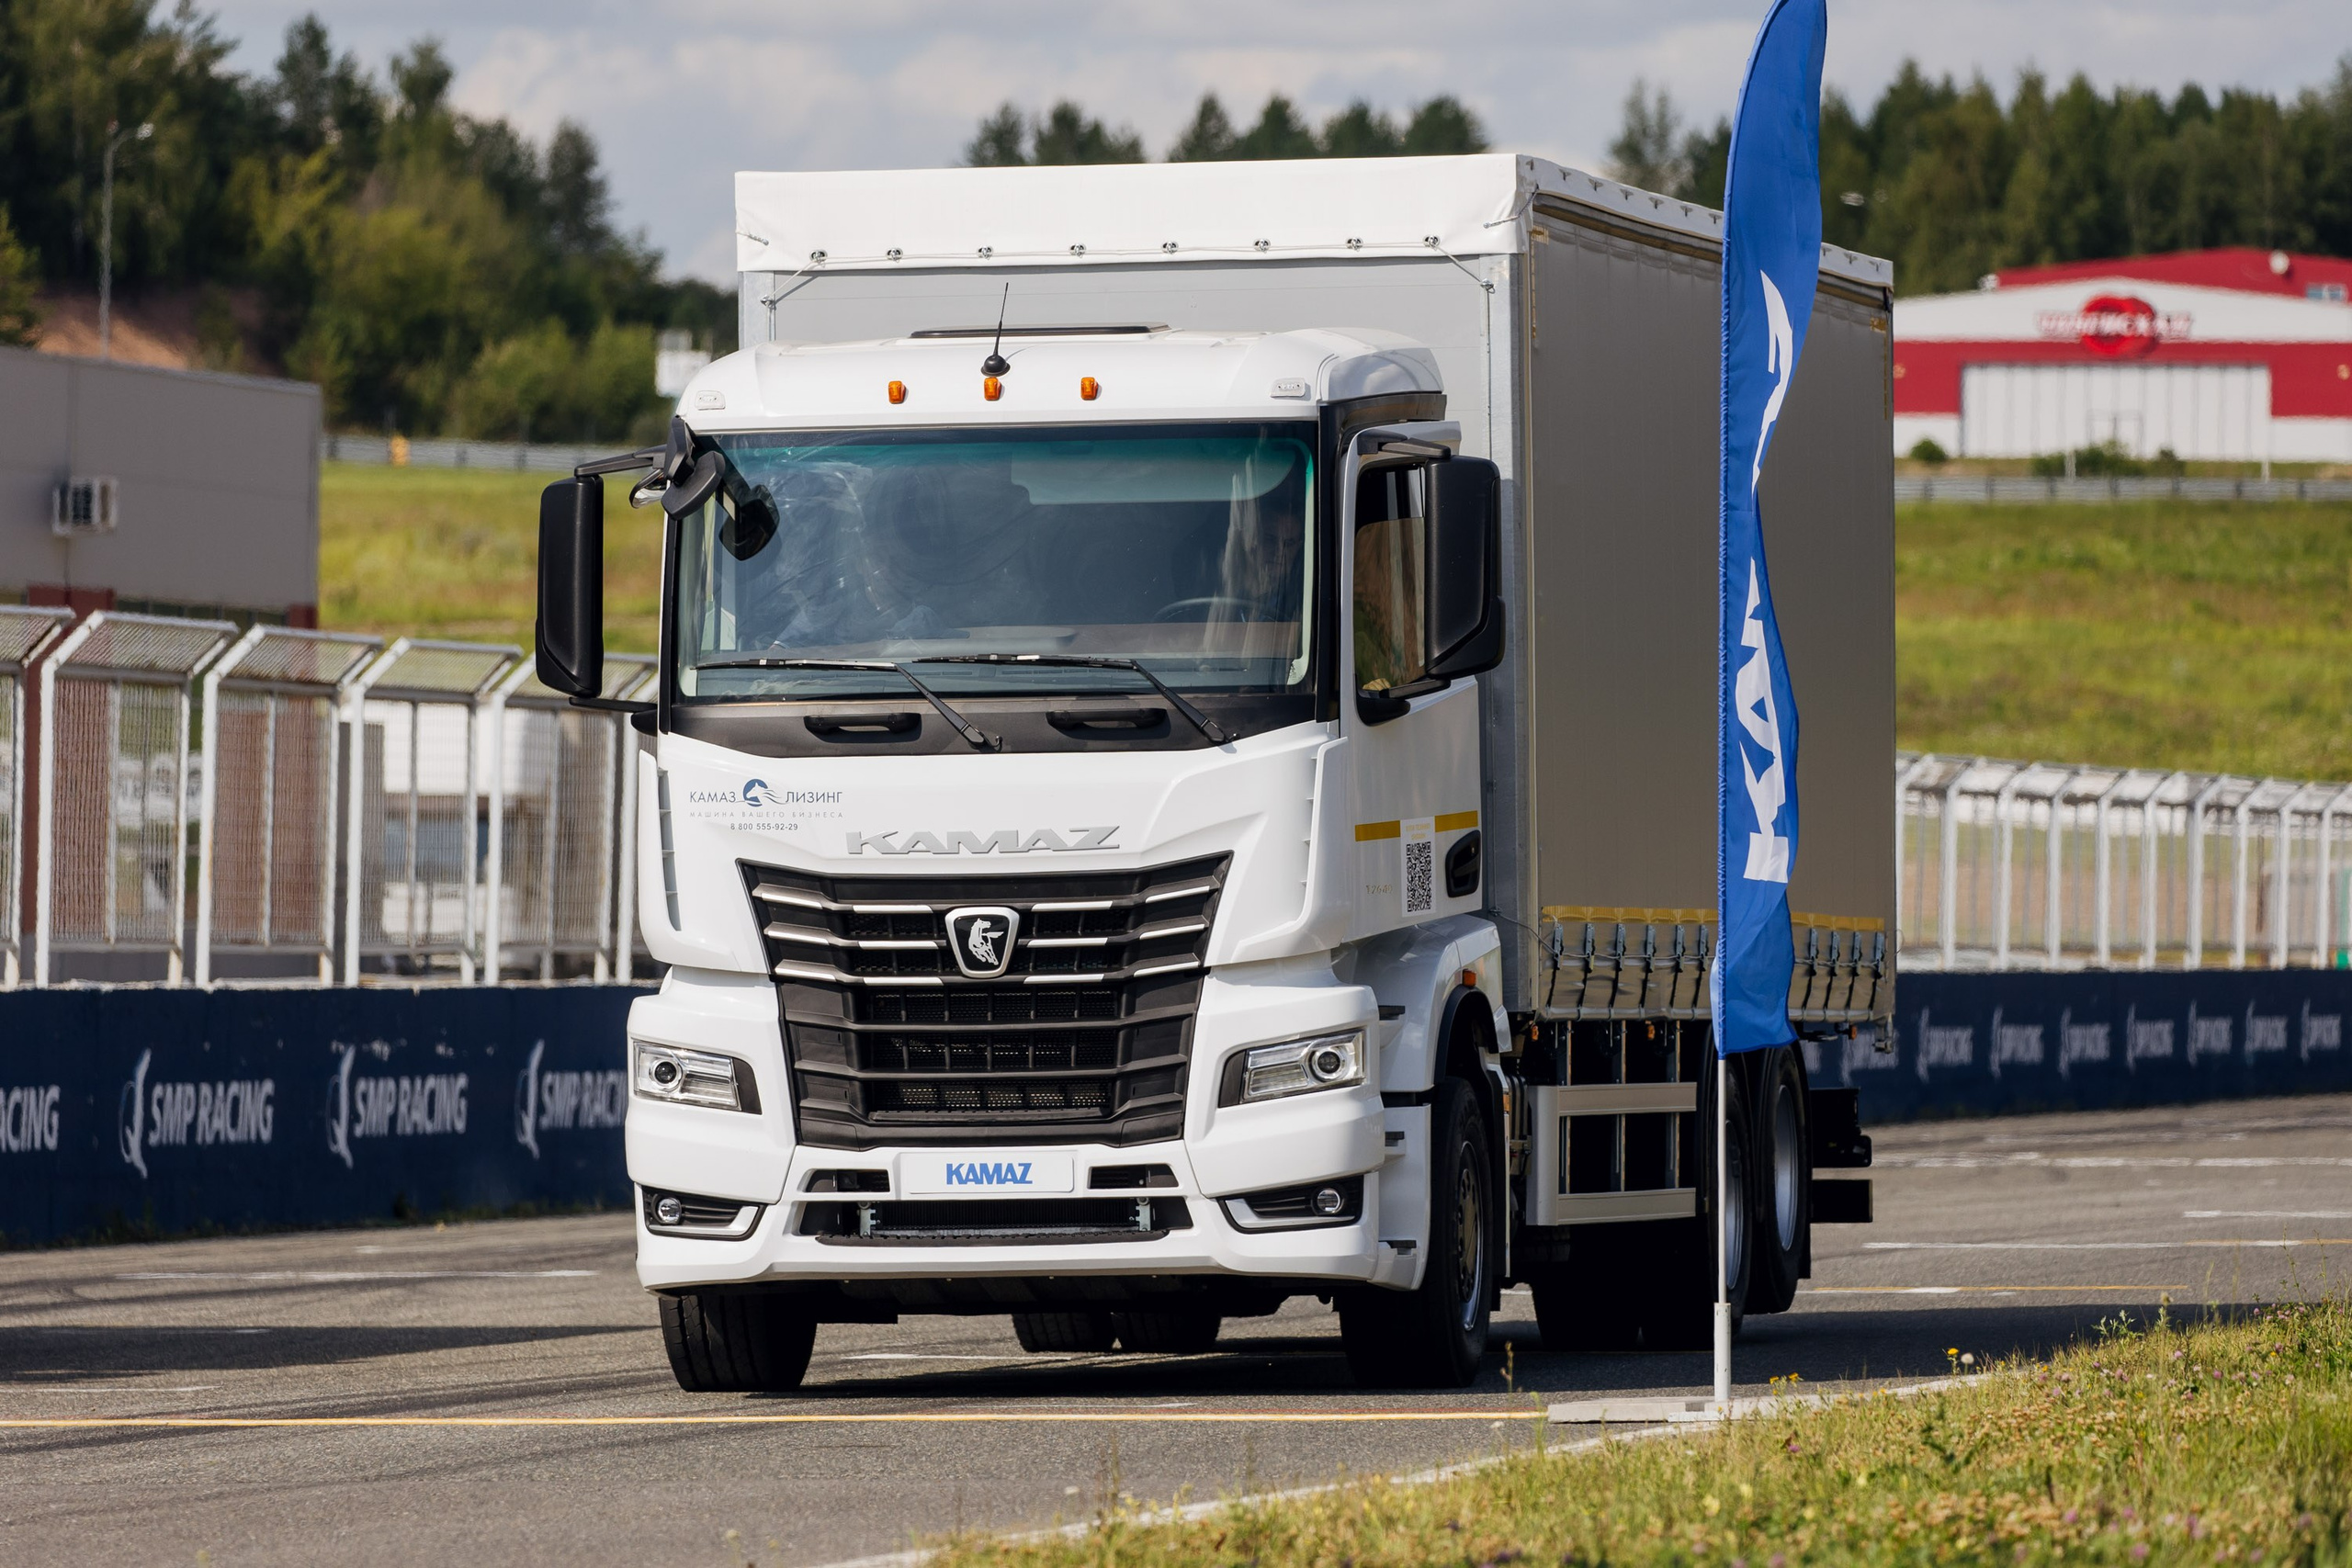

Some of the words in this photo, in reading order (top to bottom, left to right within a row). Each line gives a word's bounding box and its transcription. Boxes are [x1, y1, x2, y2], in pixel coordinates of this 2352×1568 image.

[1736, 269, 1793, 884] KAZ
[689, 791, 737, 804] КАМАЗ
[785, 791, 843, 804] ЛИЗИНГ
[845, 825, 1121, 855] KAMAZ
[0, 1084, 62, 1153] CING
[148, 1081, 196, 1146] SMP
[195, 1078, 275, 1145] RACING
[354, 1076, 397, 1138] SMP
[396, 1073, 468, 1136] RACING
[946, 1163, 1033, 1185] KAMAZ
